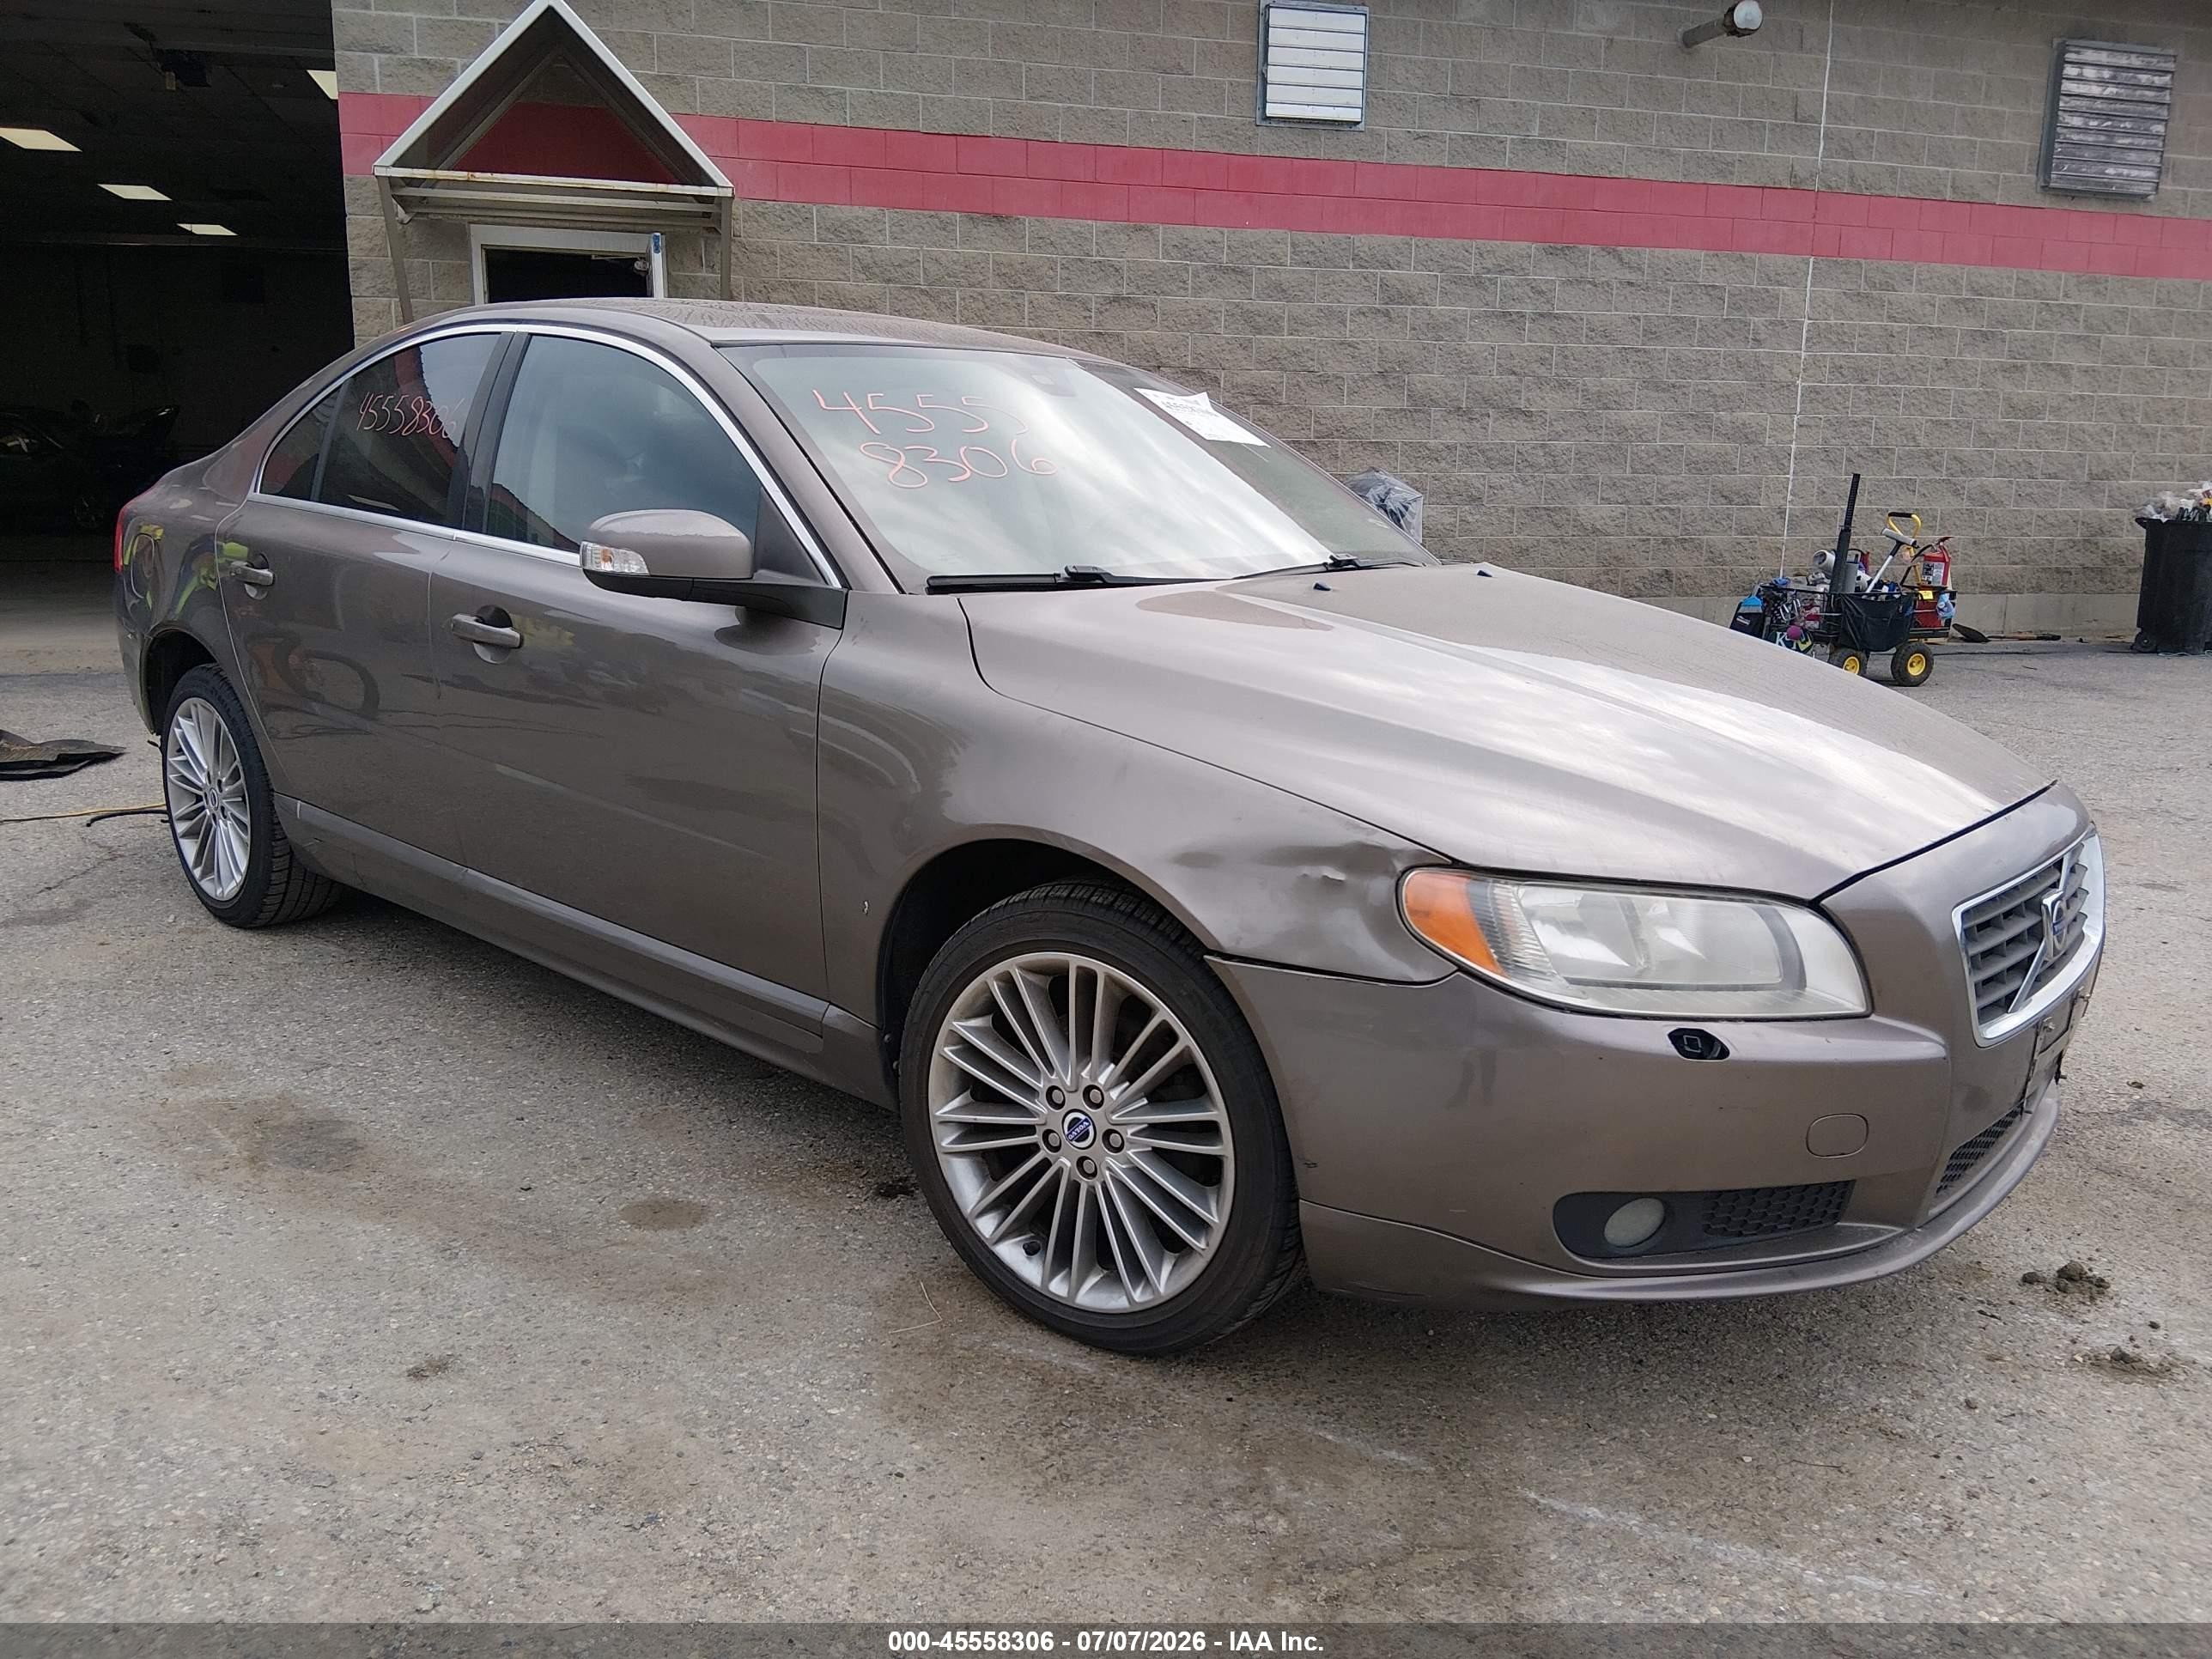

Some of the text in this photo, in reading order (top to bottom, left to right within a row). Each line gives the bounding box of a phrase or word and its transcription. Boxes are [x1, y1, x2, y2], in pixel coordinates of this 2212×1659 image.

[356, 392, 465, 438] 45558306
[812, 388, 1029, 434] 4555
[860, 440, 1058, 488] 8306
[1067, 1121, 1090, 1139] VOLVO
